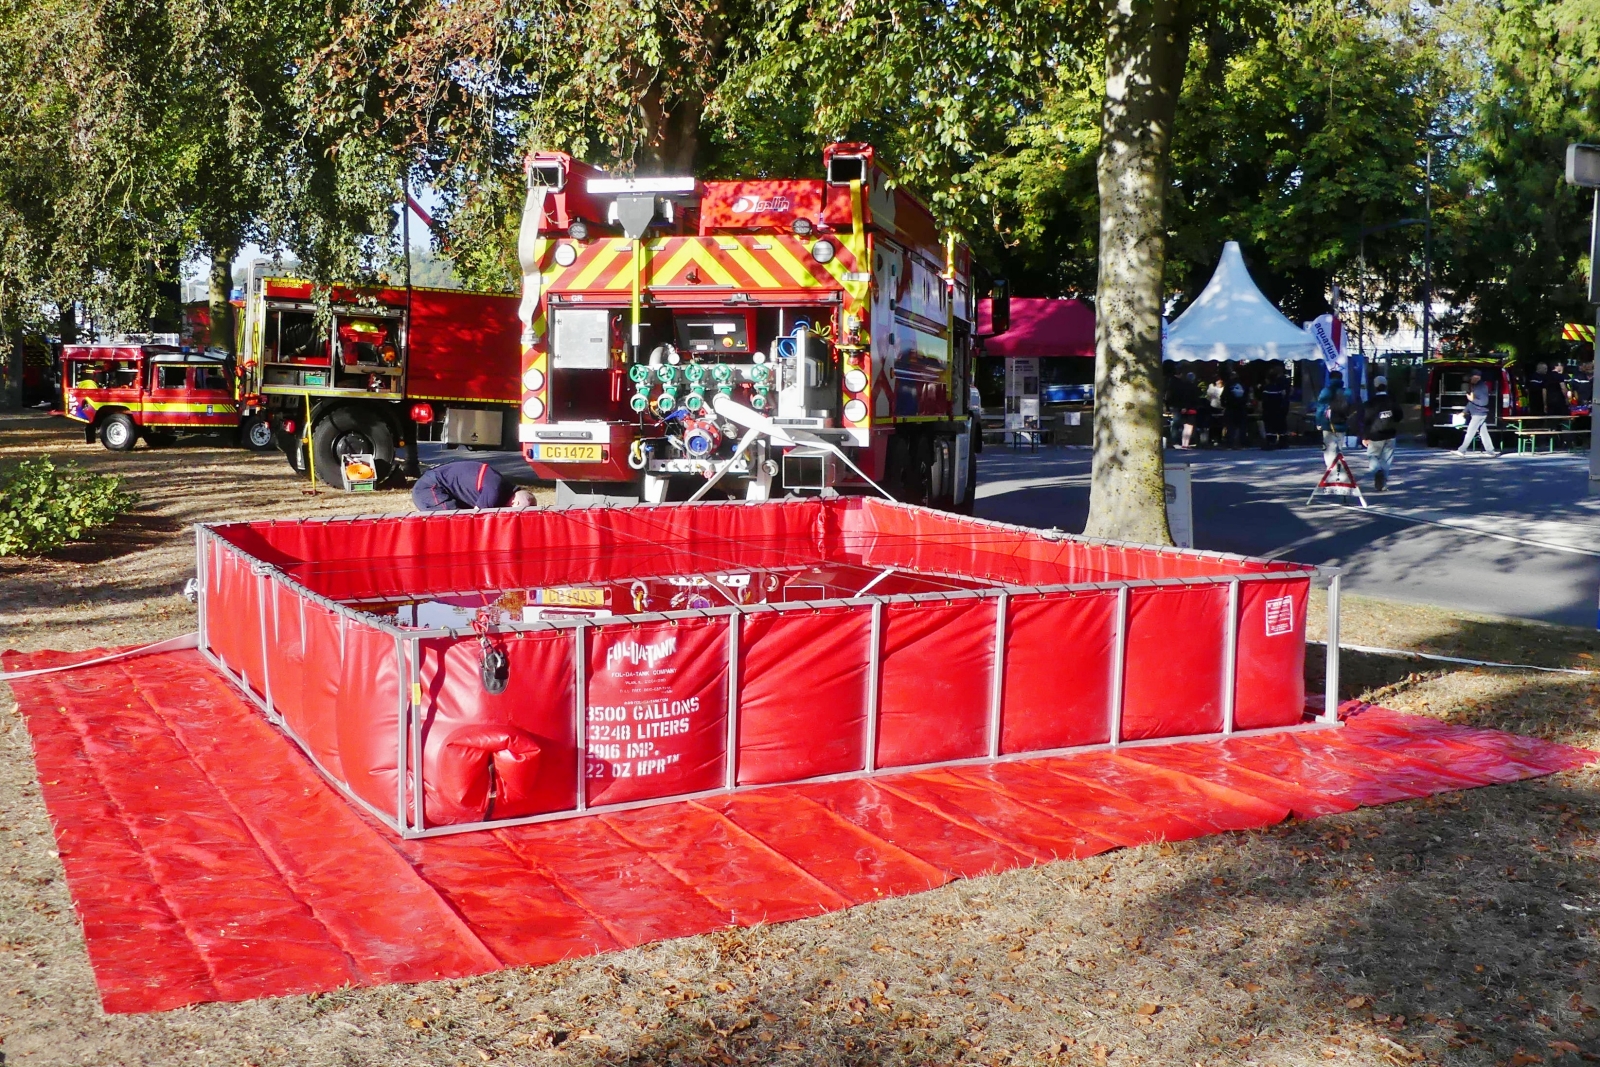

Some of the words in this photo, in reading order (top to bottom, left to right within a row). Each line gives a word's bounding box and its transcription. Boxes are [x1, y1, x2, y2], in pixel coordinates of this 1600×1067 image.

[1314, 322, 1337, 360] aquarius
[546, 446, 594, 459] CG1472
[611, 670, 650, 678] FOL-DA-TANK
[652, 667, 678, 676] COMPANY
[585, 706, 626, 722] 3500
[633, 696, 700, 721] GALLONS
[637, 717, 690, 740] LITERS
[585, 743, 620, 759] 2916
[626, 742, 660, 759] IMP.
[585, 763, 605, 778] 22
[611, 762, 631, 778] OZ
